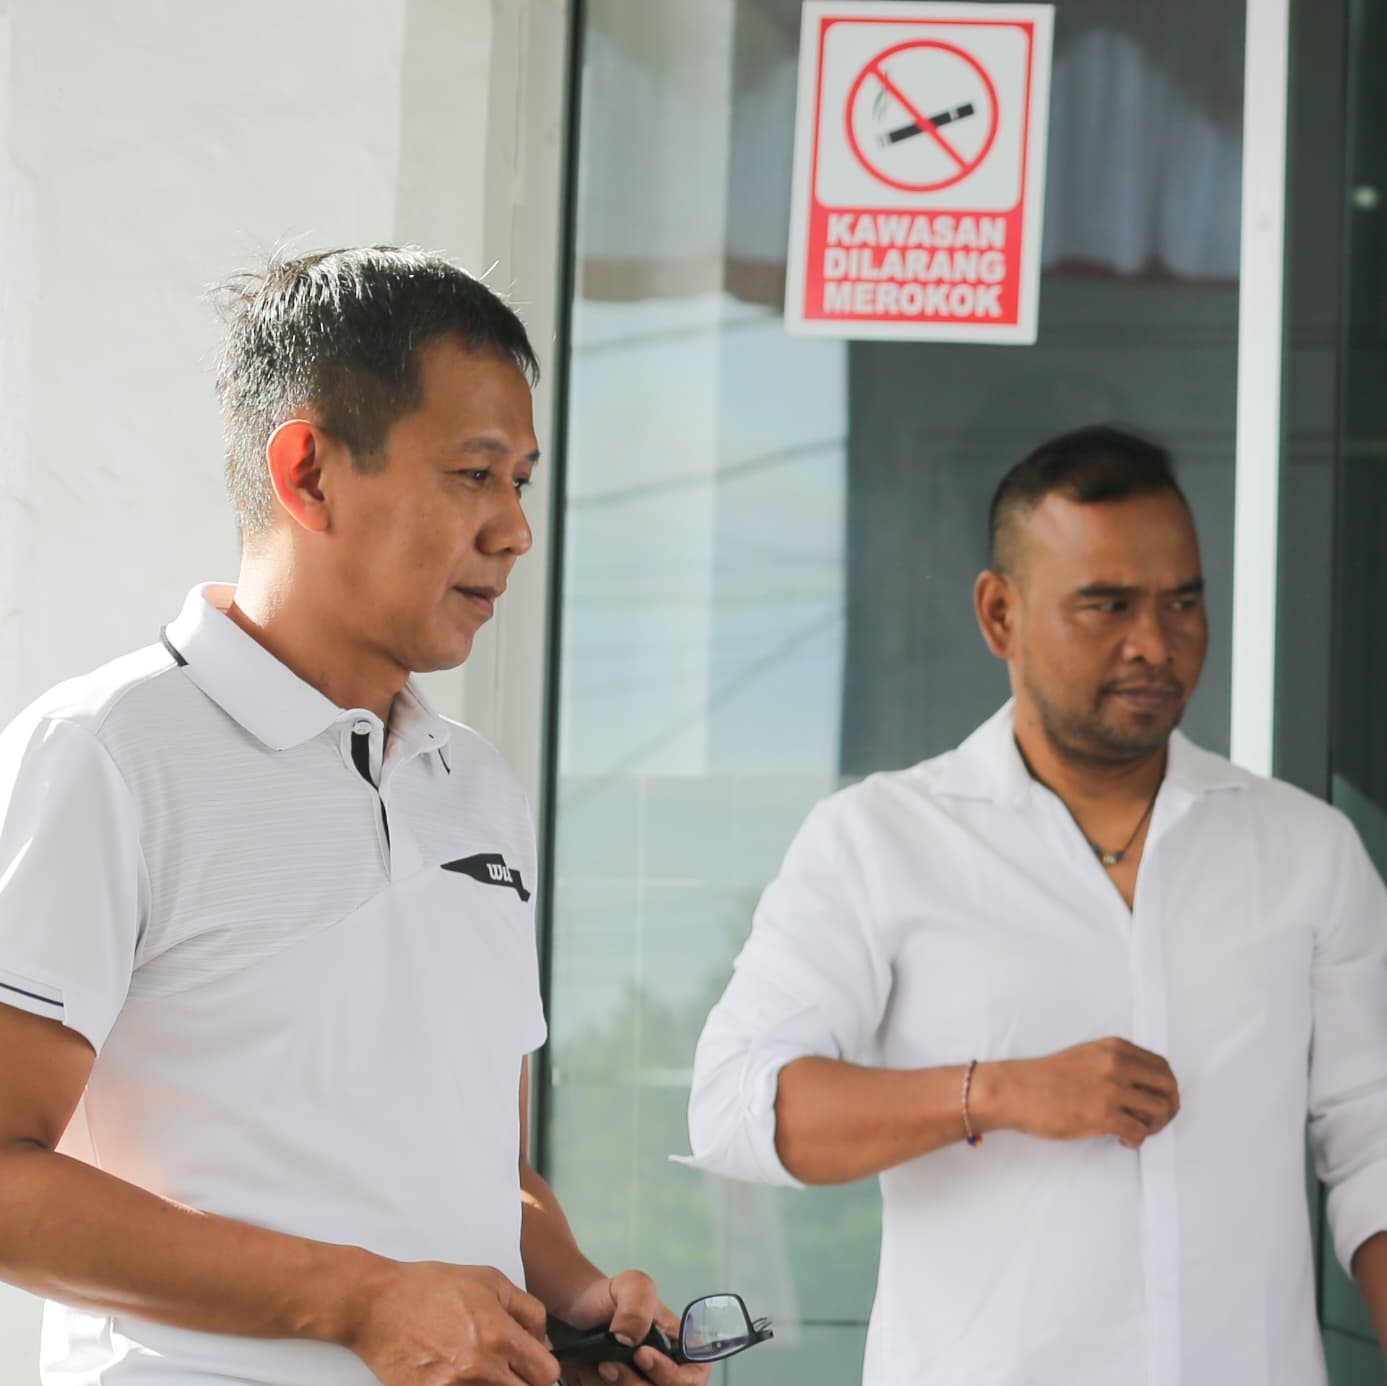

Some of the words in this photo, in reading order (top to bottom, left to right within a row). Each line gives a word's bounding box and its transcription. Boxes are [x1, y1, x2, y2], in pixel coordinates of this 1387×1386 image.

[826, 213, 1007, 249] KAWASAN
[823, 247, 1006, 283] DILARANG
[822, 281, 1004, 317] MEROKOK
